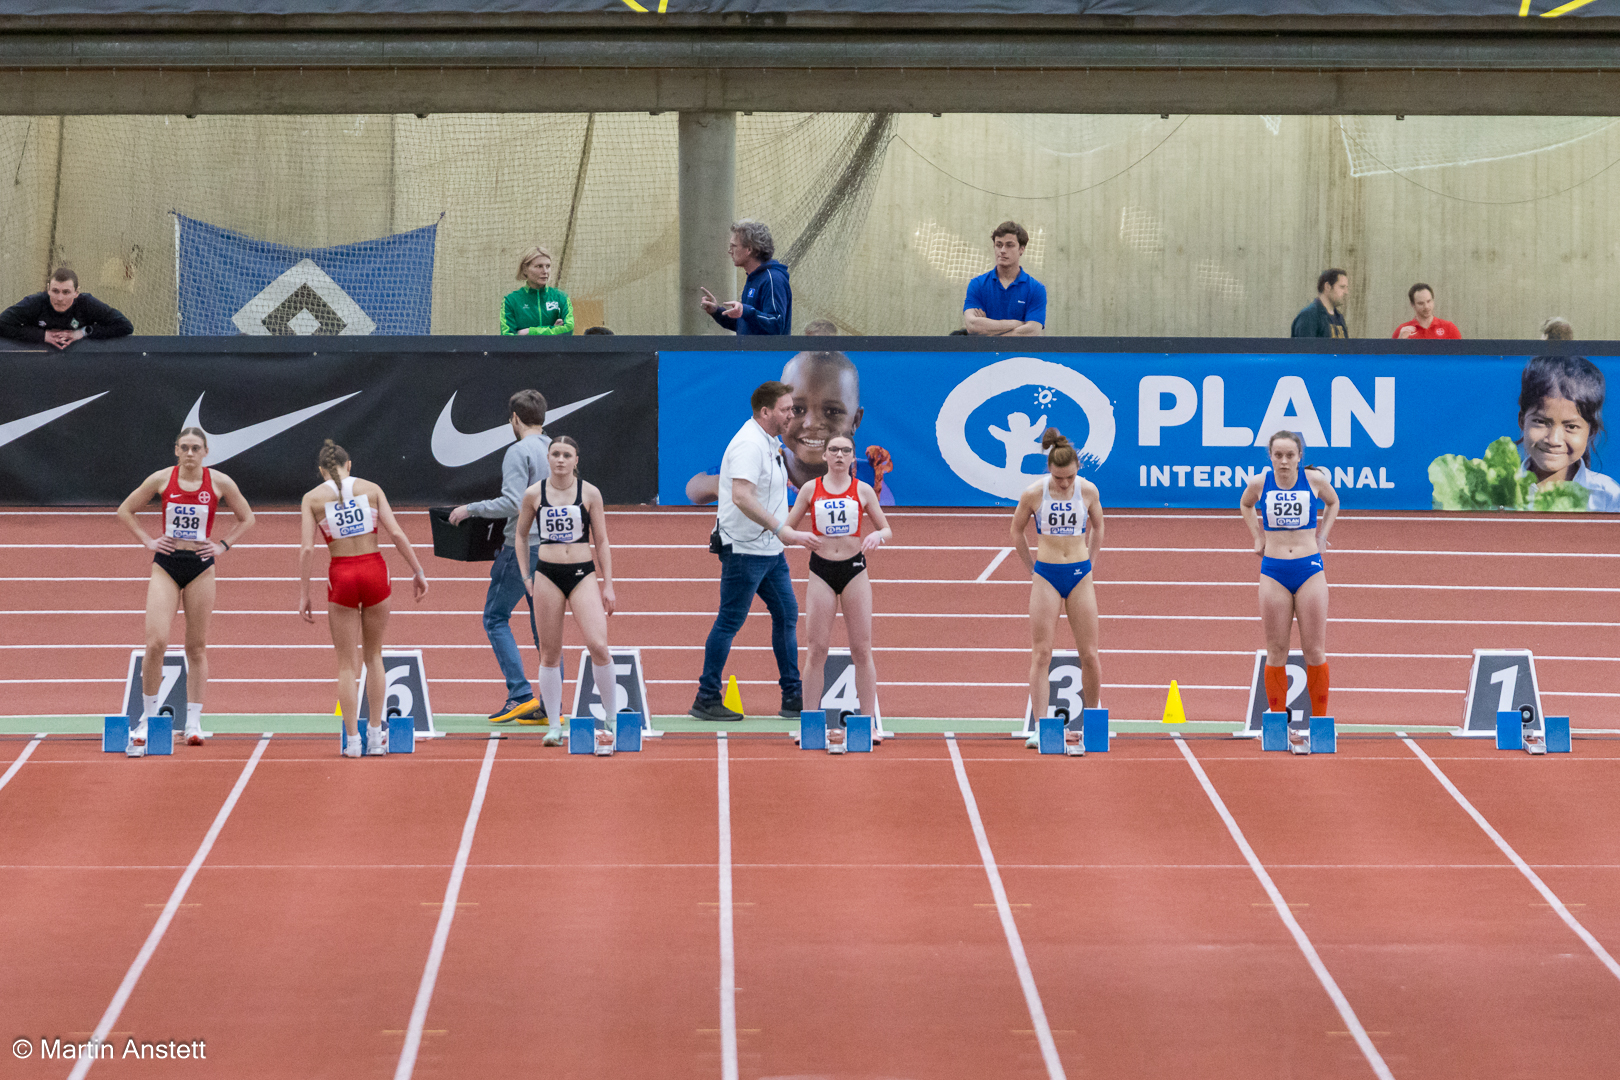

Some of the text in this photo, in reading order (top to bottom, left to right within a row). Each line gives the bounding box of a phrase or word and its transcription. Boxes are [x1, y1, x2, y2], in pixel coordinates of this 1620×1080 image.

[1138, 375, 1395, 448] PLAN
[1139, 465, 1395, 489] INTERNNAL
[172, 515, 200, 529] 438
[334, 508, 364, 527] 350
[545, 517, 574, 533] 563
[828, 510, 847, 524] 14
[1048, 512, 1077, 526] 614
[1273, 502, 1302, 516] 529
[487, 522, 494, 541] 1
[141, 665, 181, 714] 7
[385, 665, 413, 717] 6
[589, 664, 632, 719] 5
[821, 664, 860, 713] 4
[1046, 665, 1083, 719] 3
[1270, 664, 1307, 721] 2
[1490, 665, 1519, 711] 1
